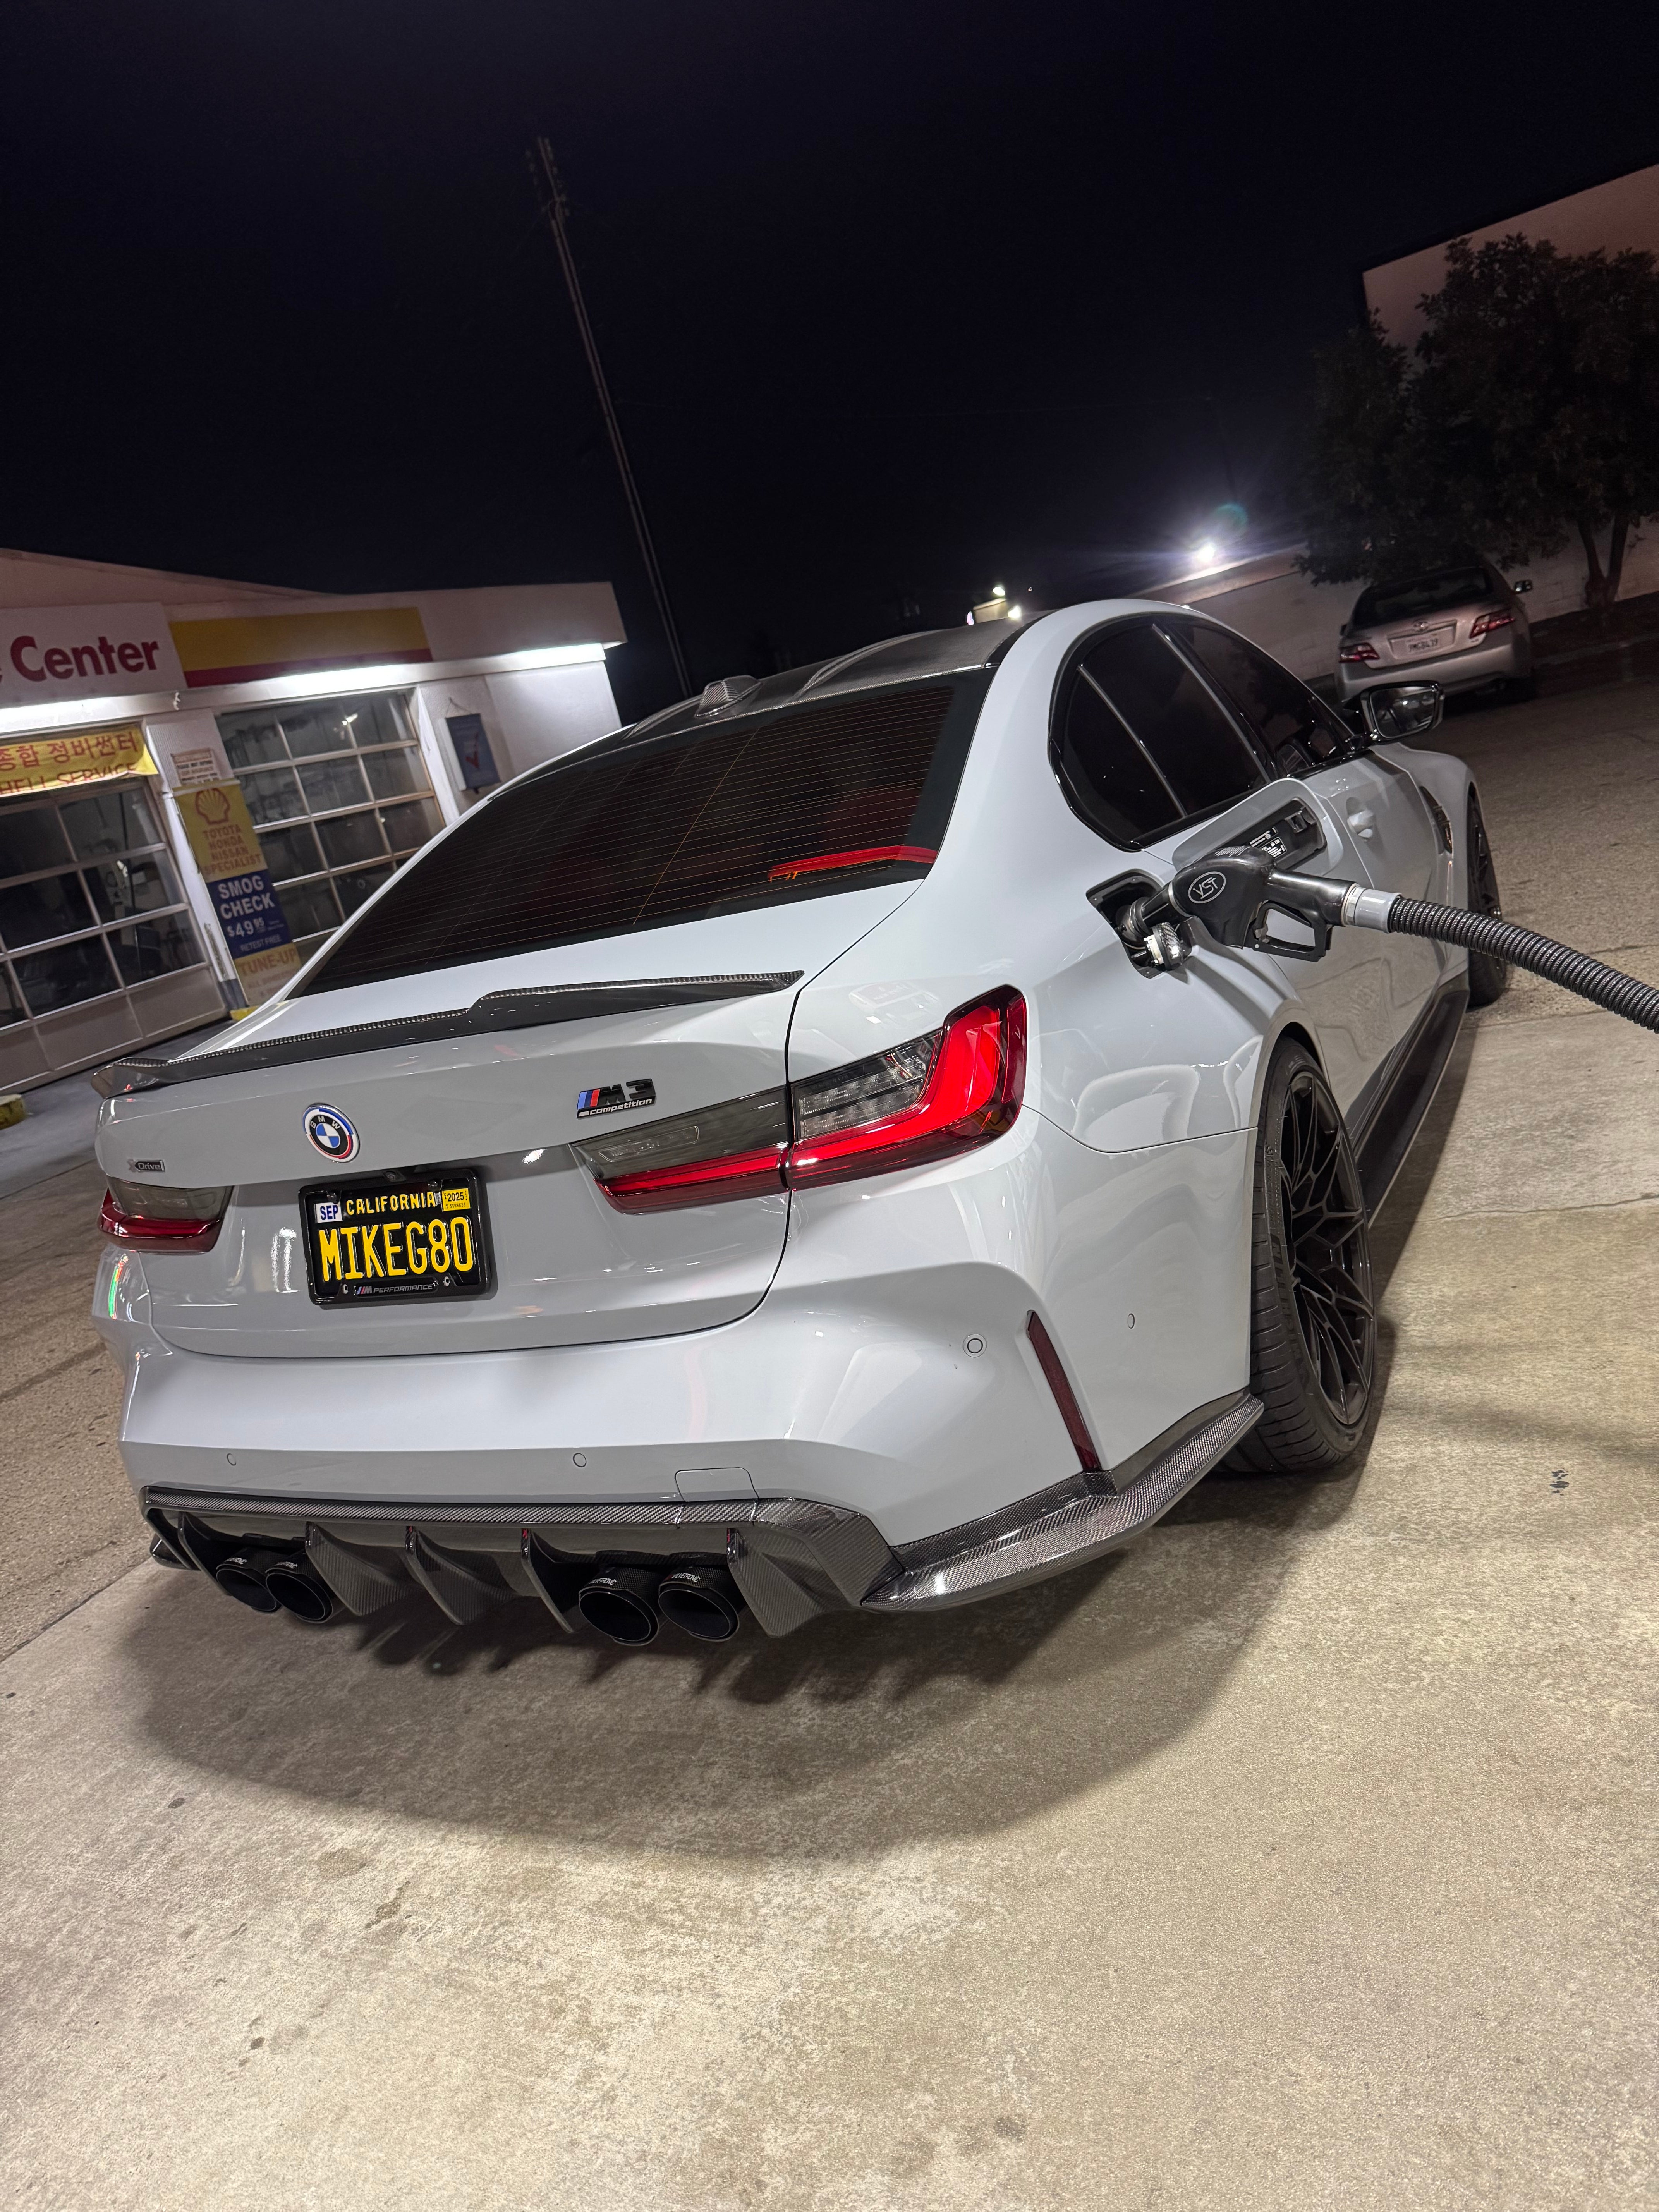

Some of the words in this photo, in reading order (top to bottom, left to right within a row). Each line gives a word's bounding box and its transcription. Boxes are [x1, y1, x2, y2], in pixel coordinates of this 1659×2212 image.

[10, 635, 159, 682] Center
[202, 824, 242, 838] TOYOTA
[208, 836, 244, 850] HONDA
[211, 845, 249, 862] NISSAN
[218, 875, 264, 899] SMOG
[1193, 877, 1218, 899] VST
[220, 893, 275, 919] CHECK
[237, 948, 295, 976] TUNE-UP
[590, 1098, 653, 1115] competition
[310, 1116, 341, 1130] BMW
[346, 1192, 436, 1216] CALIFORNIA
[447, 1192, 464, 1202] 2025
[320, 1205, 338, 1220] SEP
[319, 1217, 473, 1282] MIKEG80
[373, 1284, 433, 1293] PERFORMANCE
